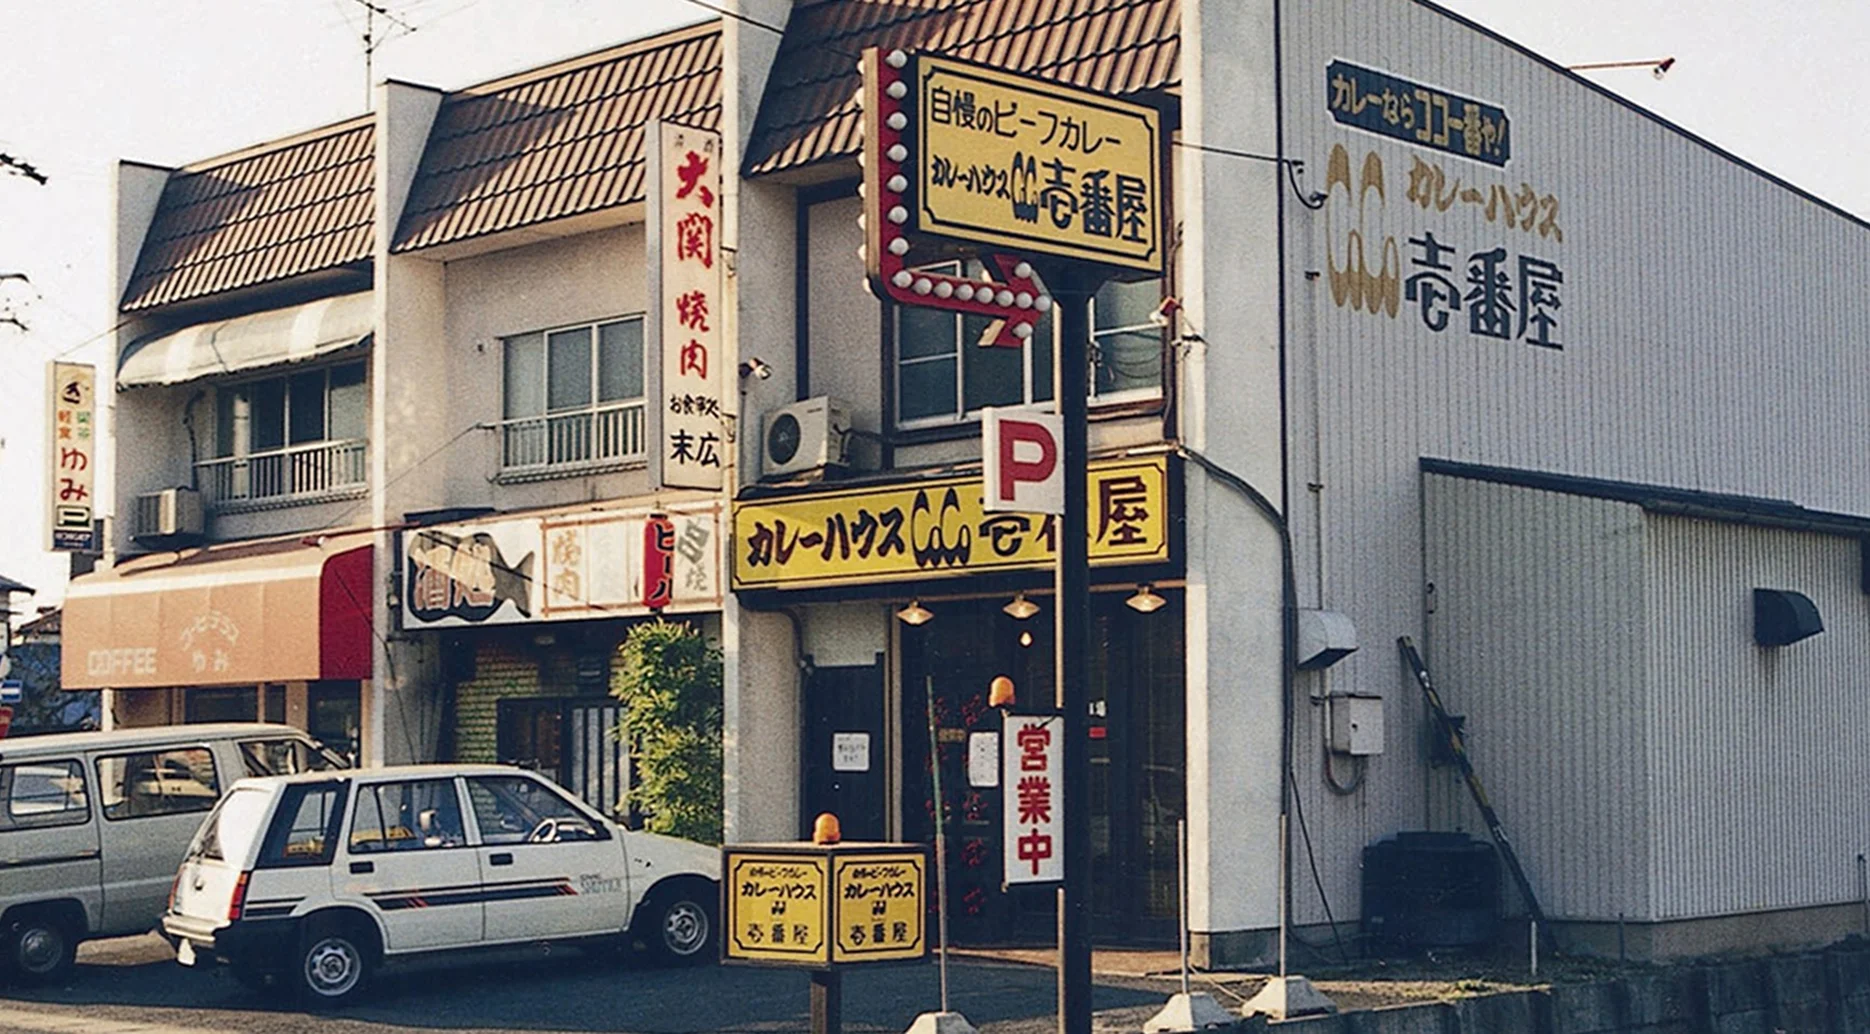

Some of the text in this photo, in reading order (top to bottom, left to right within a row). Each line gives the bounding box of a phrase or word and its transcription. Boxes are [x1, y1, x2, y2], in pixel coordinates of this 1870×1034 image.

[931, 85, 1121, 154] 自慢のビーフカレー
[930, 154, 1010, 200] カレーハウス
[1407, 153, 1563, 244] カレーハウス
[1405, 230, 1564, 351] 壱番屋
[60, 446, 88, 501] ゆみ
[670, 428, 720, 469] 末広
[1000, 418, 1057, 501] P
[746, 506, 906, 568] カレーハウス
[86, 646, 158, 678] COFFEE
[1016, 722, 1052, 876] 営業中
[741, 881, 818, 901] カレーハウス
[843, 881, 916, 900] カレーハウス
